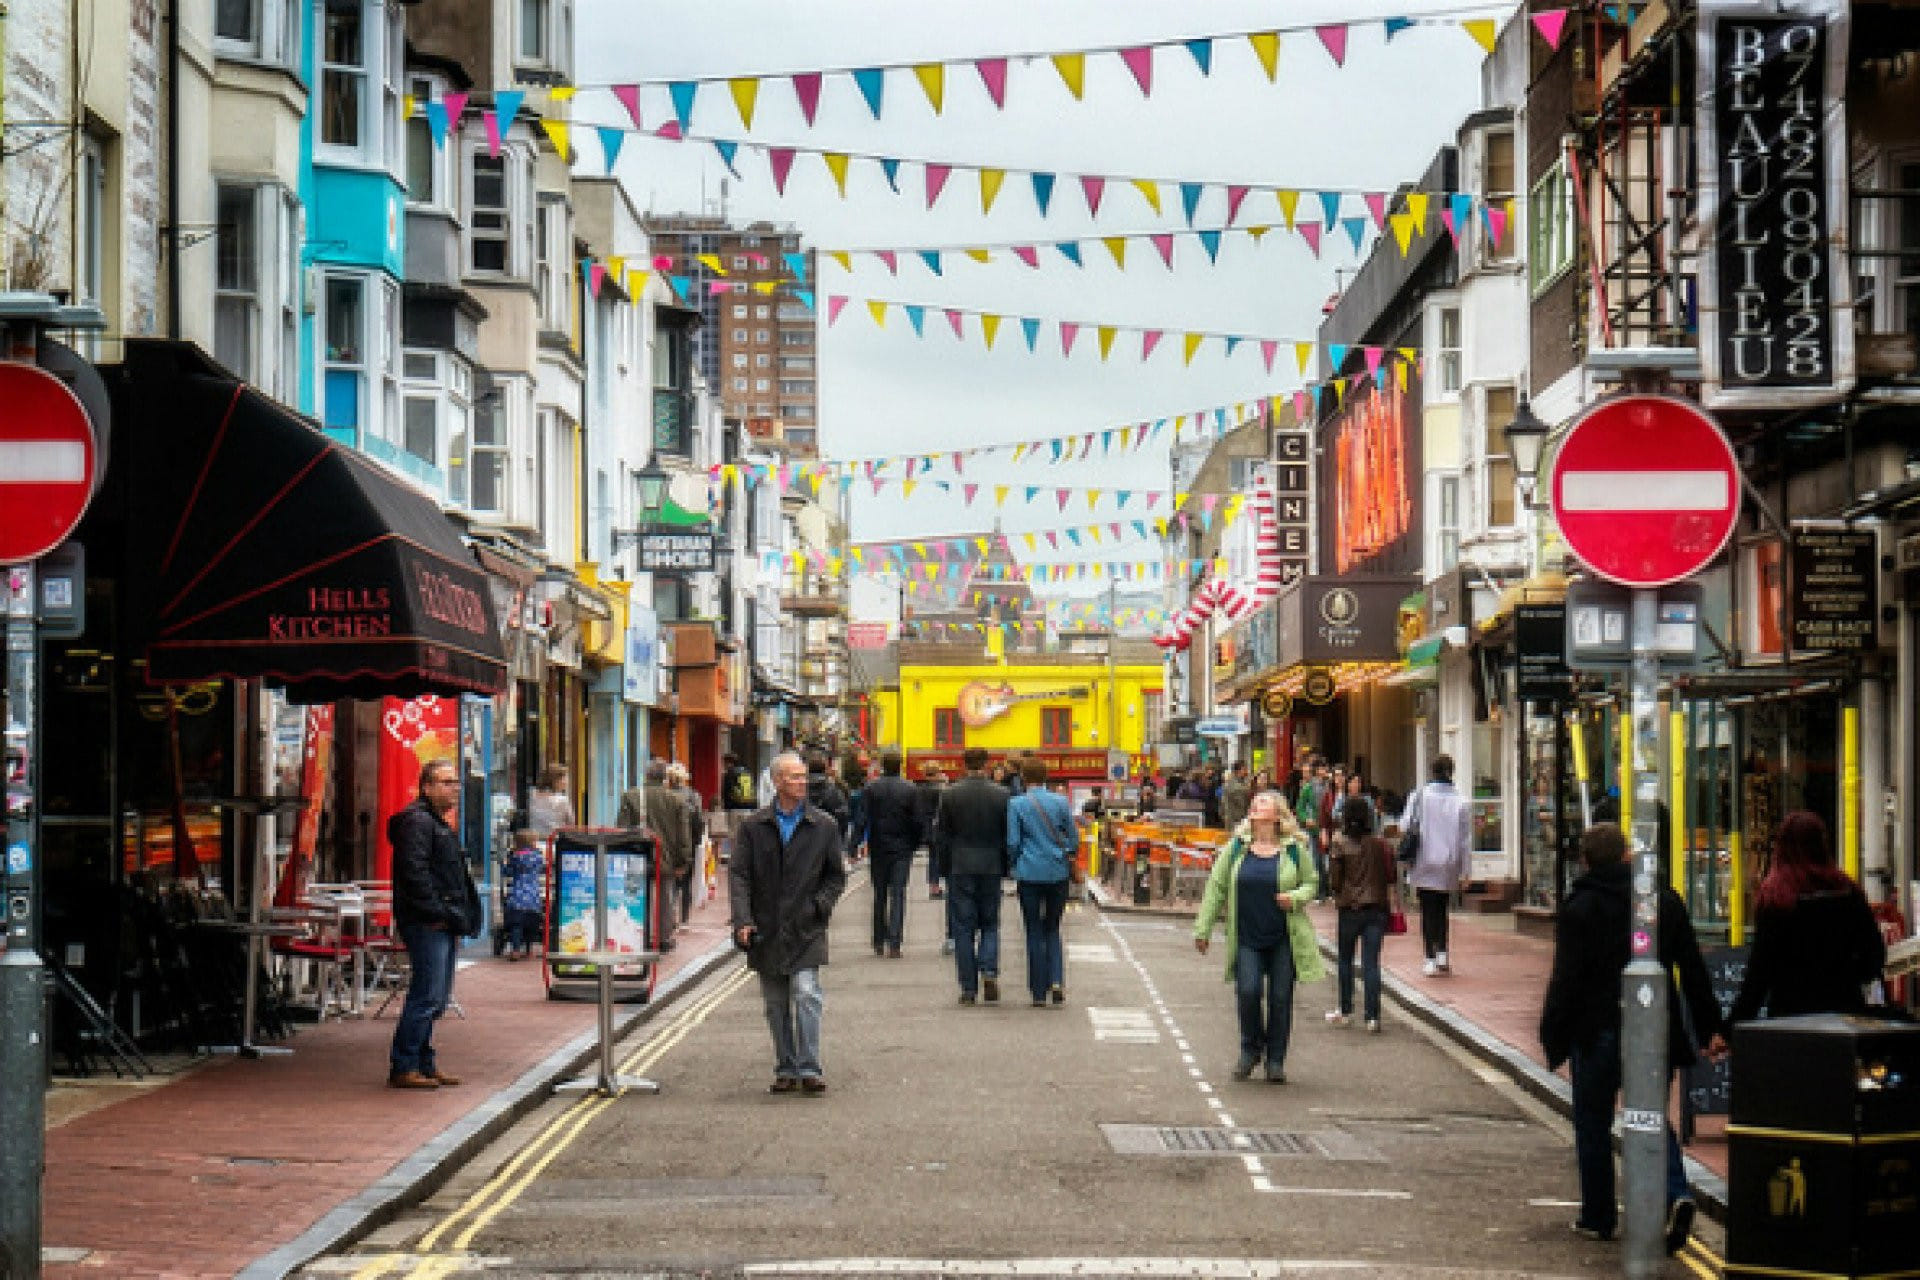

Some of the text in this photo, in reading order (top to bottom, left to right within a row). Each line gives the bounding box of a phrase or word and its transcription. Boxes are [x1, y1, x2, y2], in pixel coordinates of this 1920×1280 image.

[1728, 26, 1775, 380] BEAULIEU
[309, 587, 390, 611] HELLS
[269, 614, 390, 639] KITCHEN
